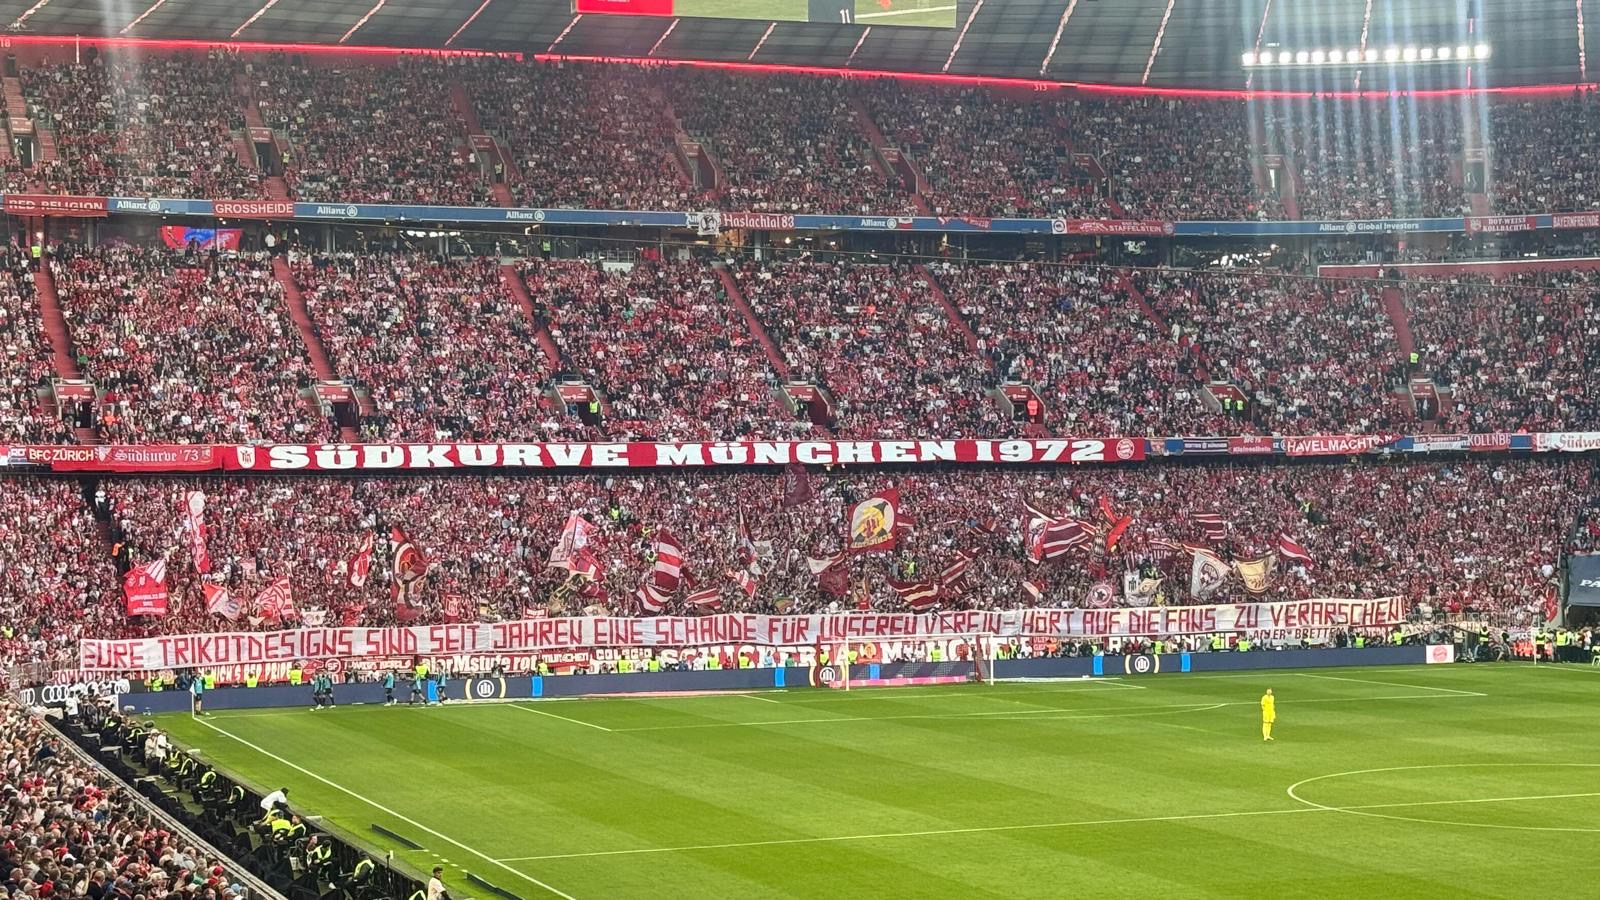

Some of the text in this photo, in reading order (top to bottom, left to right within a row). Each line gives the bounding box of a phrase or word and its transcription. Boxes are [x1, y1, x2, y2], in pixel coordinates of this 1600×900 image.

[9, 200, 103, 210] RED RELIGION
[117, 200, 147, 209] Allianz
[215, 203, 294, 214] GROSSHEIDE
[317, 206, 346, 215] Allianz
[506, 211, 533, 219] Allianz
[722, 213, 795, 228] Haslachtal 83
[861, 219, 886, 227] Allianz
[1319, 221, 1420, 231] Allianz Global Investors
[29, 448, 51, 461] BFC
[53, 446, 95, 461] ZÜRICH
[114, 449, 177, 463] Südkurve
[269, 440, 1104, 469] SÜDKURVE MÜNCHEN 1972
[84, 641, 144, 669] EURE
[158, 628, 353, 666] TRIKOTDESIGNS
[366, 627, 418, 654] SIND
[430, 624, 480, 652] SEIT
[493, 619, 583, 649] JAHREN
[594, 619, 643, 645] EINE
[655, 615, 757, 645] SCHANDE
[768, 617, 809, 643] FÜR
[820, 615, 918, 638] UNSEREN
[925, 611, 1000, 635] VEREIN
[1022, 610, 1075, 634] HÖRT
[1082, 610, 1121, 634] AUF
[1129, 609, 1160, 634] DIE
[1165, 607, 1217, 632] FANS
[1234, 604, 1259, 629] ZU
